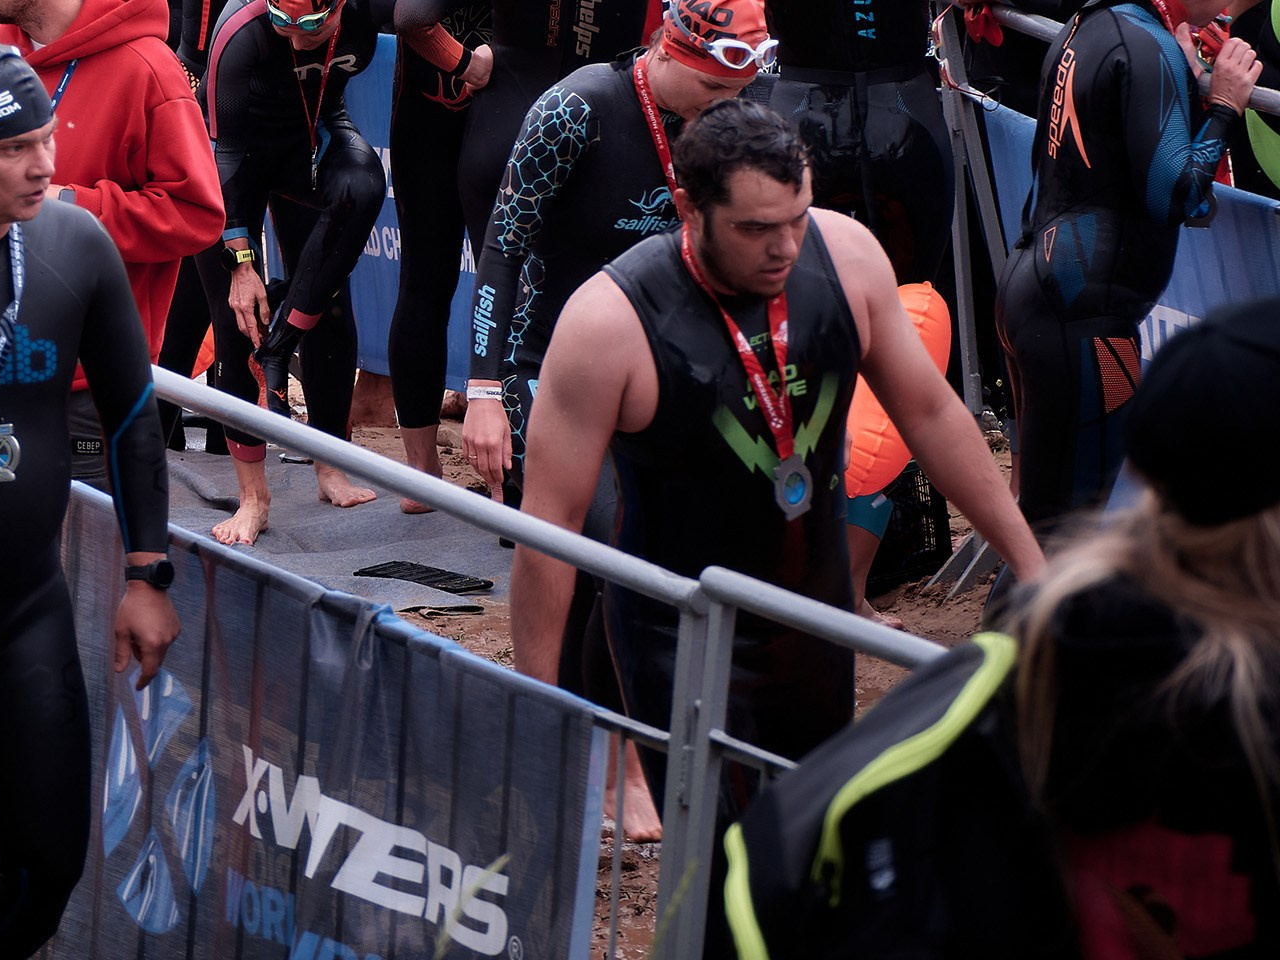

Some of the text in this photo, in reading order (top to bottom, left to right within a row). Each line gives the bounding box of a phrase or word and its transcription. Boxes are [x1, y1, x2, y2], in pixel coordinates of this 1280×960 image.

[1047, 48, 1076, 160] speedo
[474, 284, 496, 357] sailfish
[232, 744, 510, 956] X·WTERS
